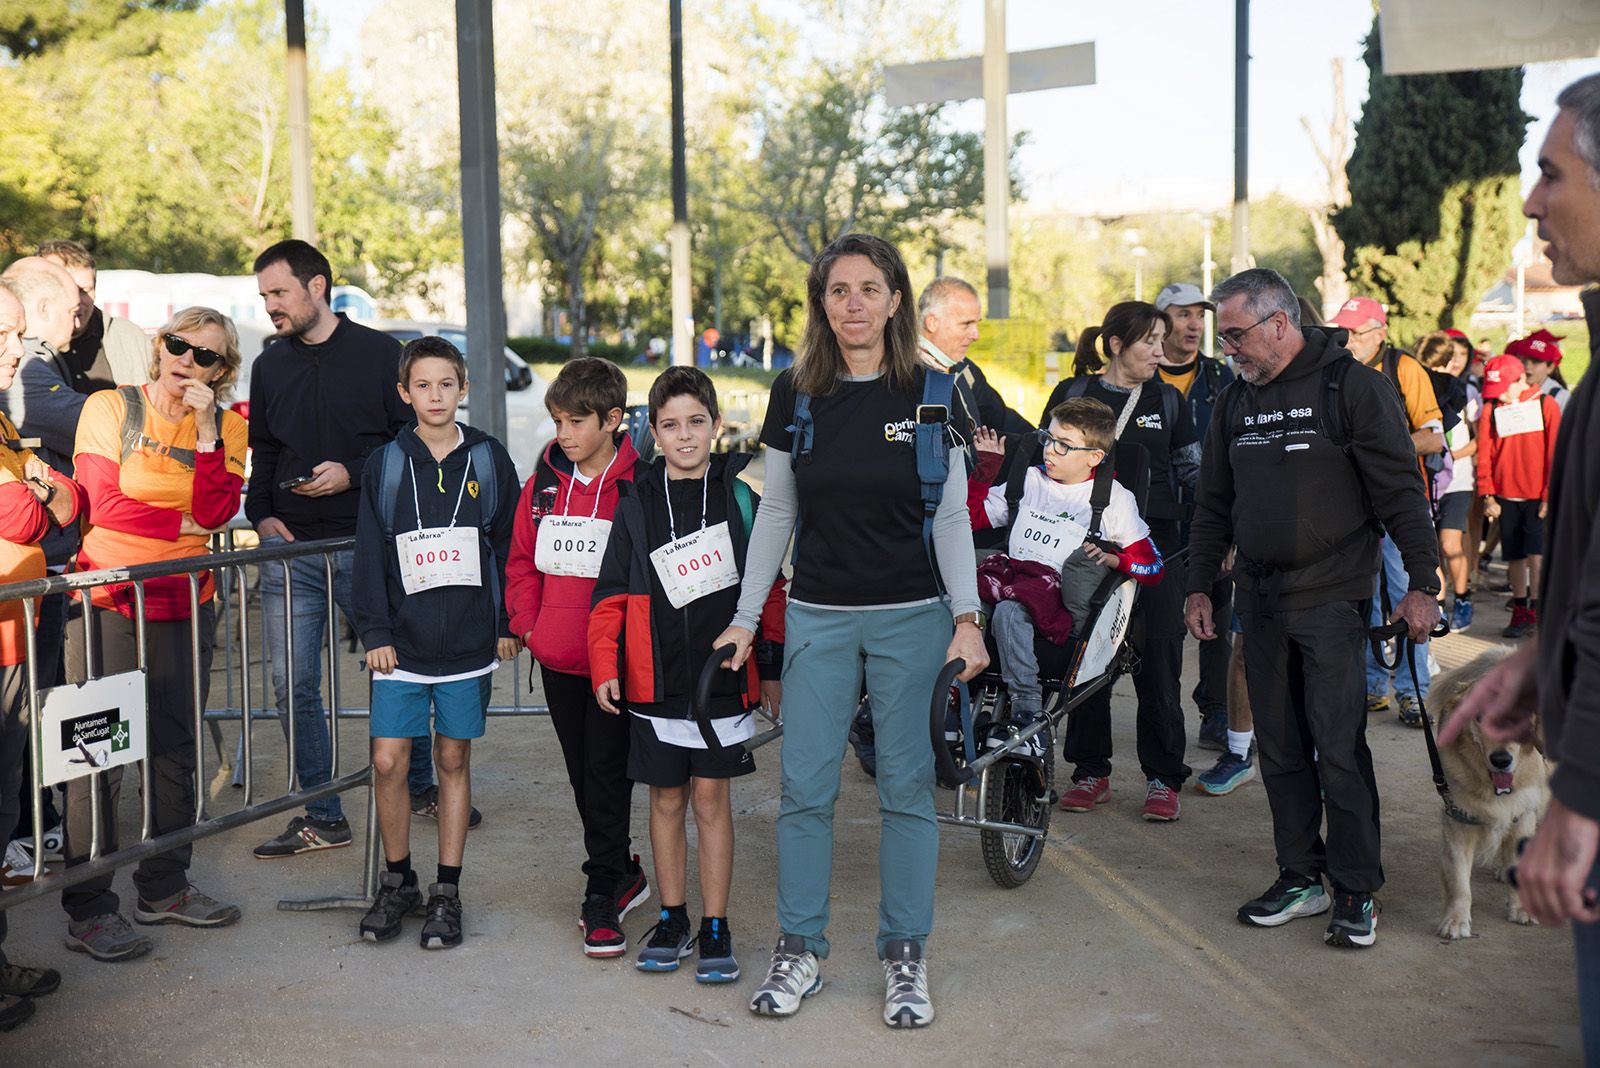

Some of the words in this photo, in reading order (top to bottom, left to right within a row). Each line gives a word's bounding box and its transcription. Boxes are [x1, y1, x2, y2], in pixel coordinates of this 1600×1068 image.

[553, 539, 597, 553] 0002
[1024, 528, 1061, 549] 0001
[415, 549, 461, 566] 0002
[677, 549, 723, 577] 0001
[74, 716, 108, 732] Ajuntament
